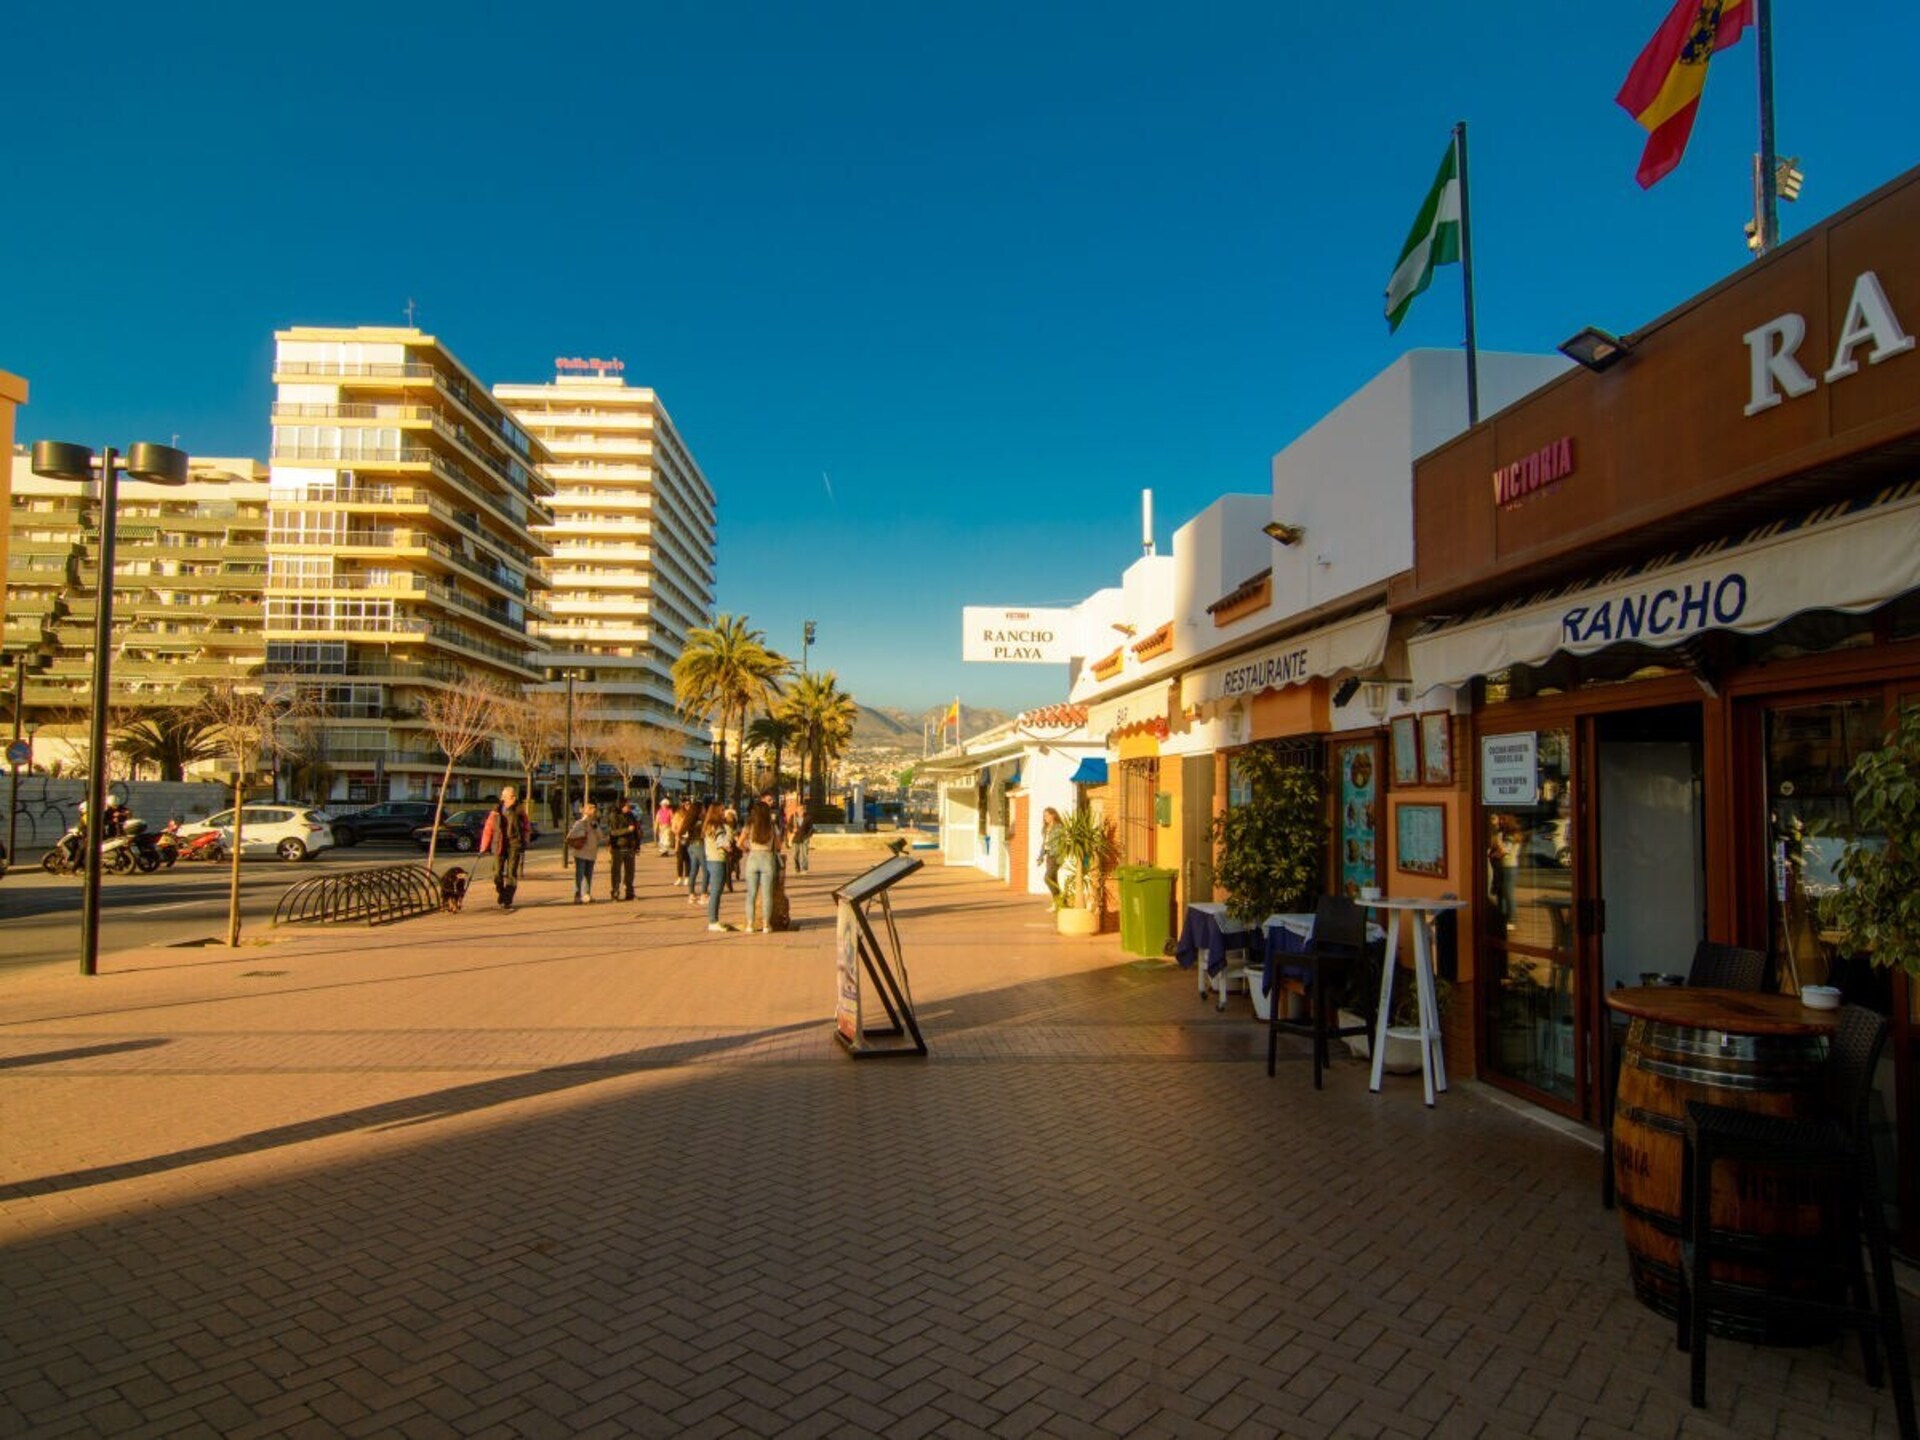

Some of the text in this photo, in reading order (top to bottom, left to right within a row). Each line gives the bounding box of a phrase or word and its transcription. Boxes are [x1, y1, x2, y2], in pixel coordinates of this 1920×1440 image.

[1493, 436, 1573, 506] VICTORIA
[1563, 573, 1747, 643] RANCHO
[983, 629, 1054, 643] RANCHO
[994, 646, 1042, 659] PLAYA
[1224, 649, 1308, 696] RESTAURANTE
